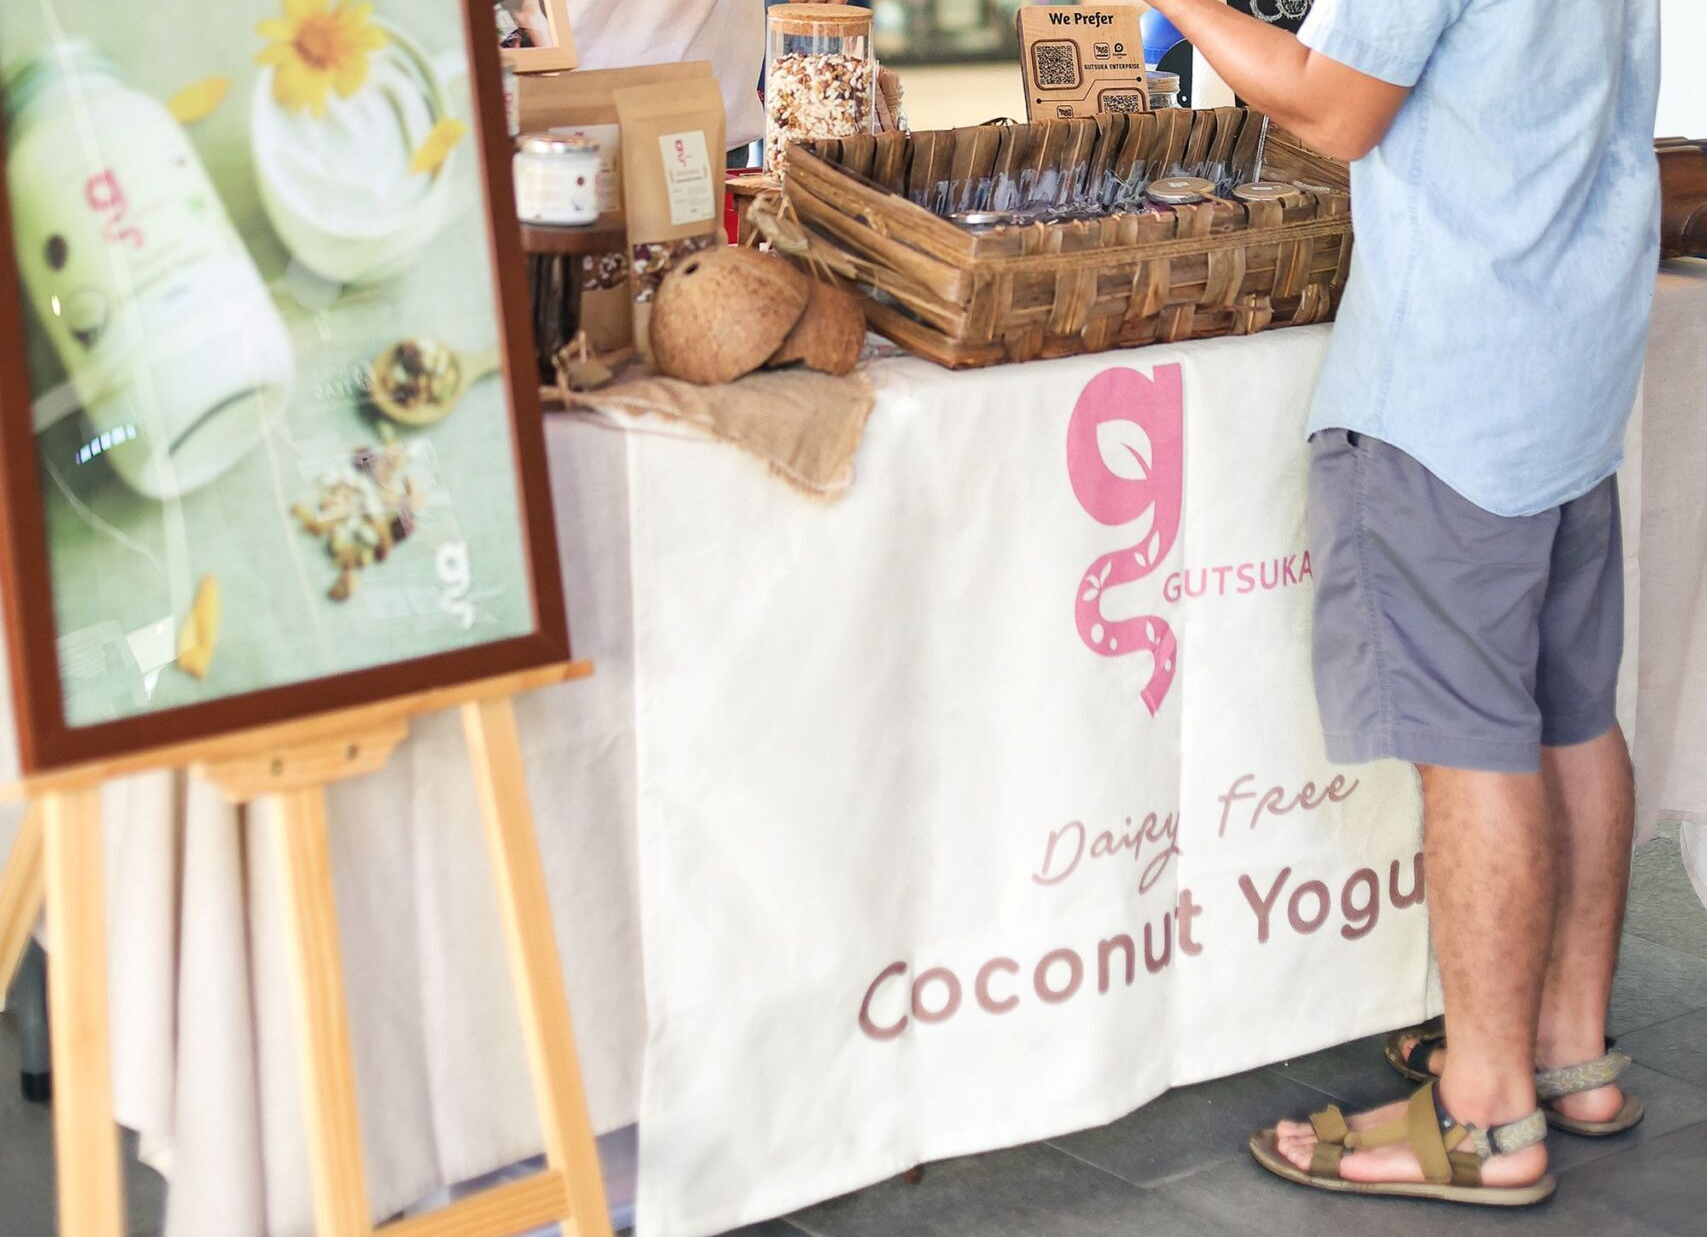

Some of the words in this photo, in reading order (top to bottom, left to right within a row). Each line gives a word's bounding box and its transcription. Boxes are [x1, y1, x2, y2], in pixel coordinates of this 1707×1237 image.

[1049, 12, 1071, 25] We
[1074, 12, 1114, 27] Prefer
[1163, 550, 1314, 604] GUTSUKA
[857, 887, 1204, 1041] Coconut
[1238, 852, 1425, 945] Yogu
